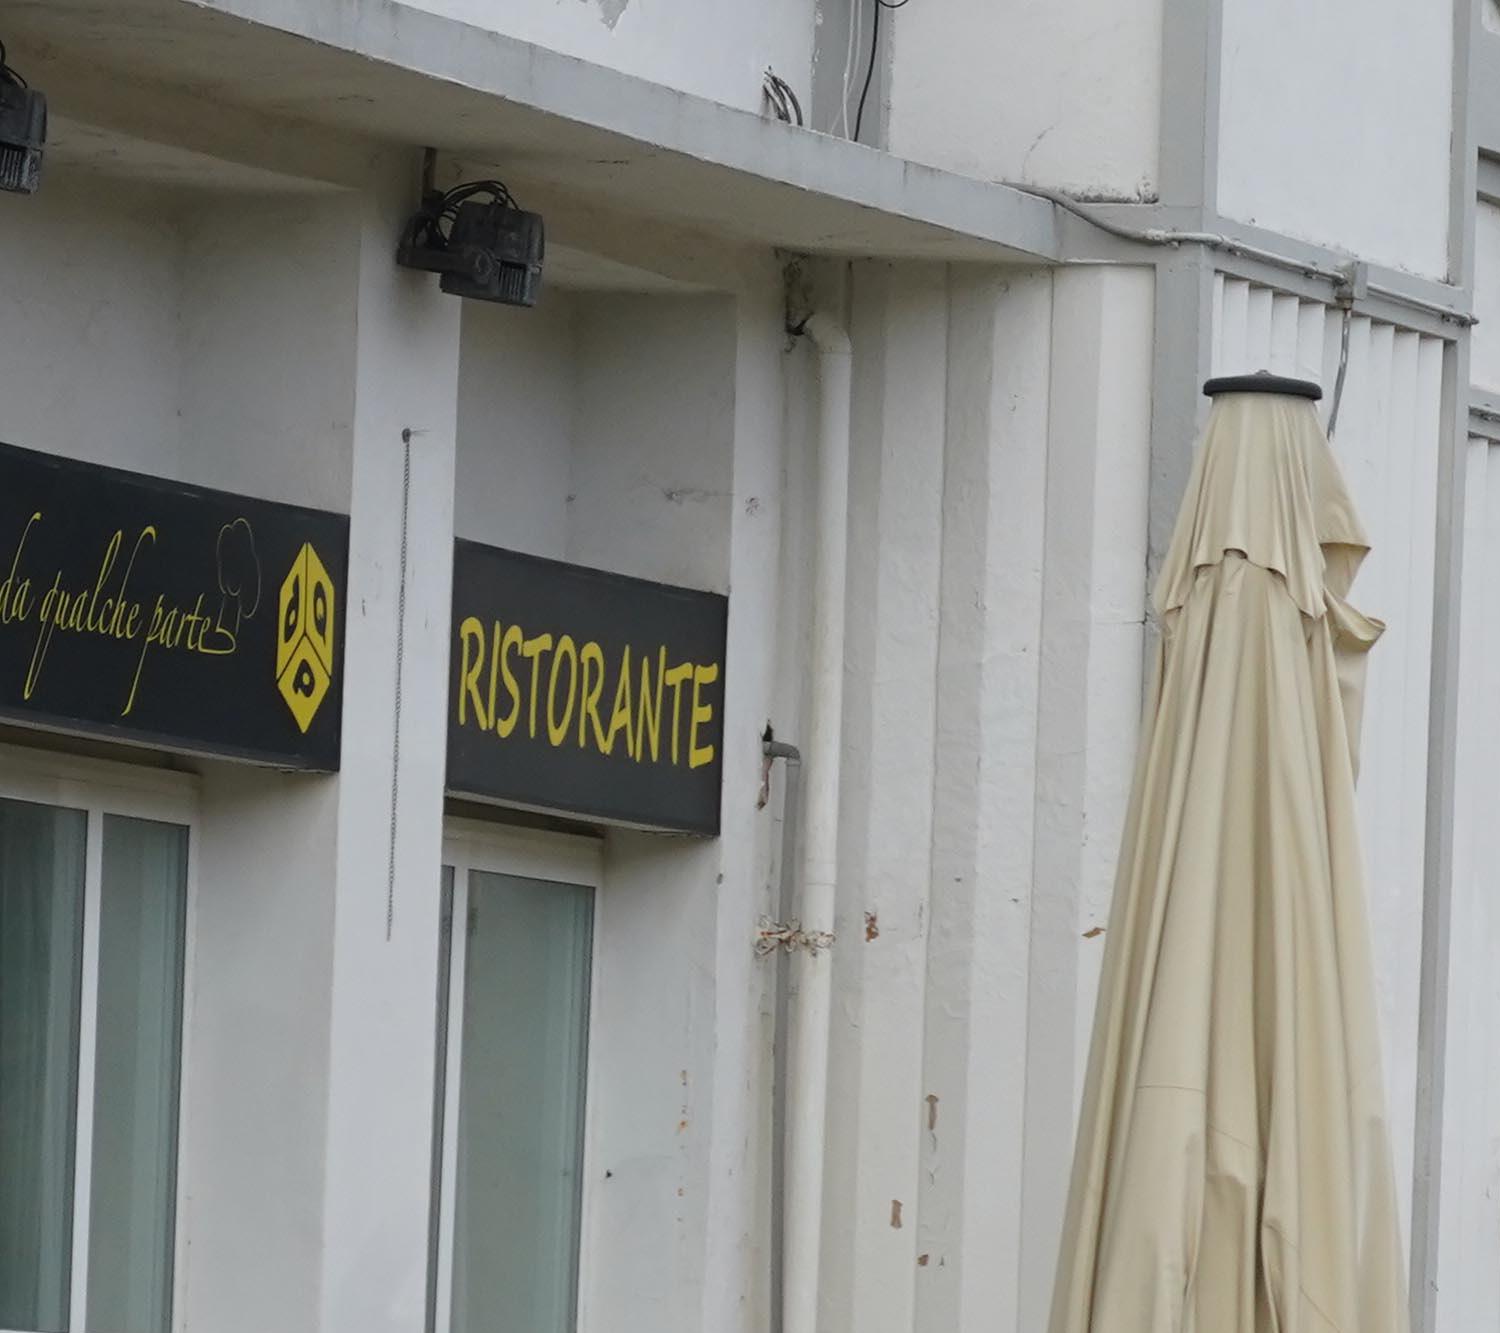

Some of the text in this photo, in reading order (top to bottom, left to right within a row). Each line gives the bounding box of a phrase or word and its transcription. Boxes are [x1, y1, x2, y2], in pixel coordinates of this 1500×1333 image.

[0, 511, 214, 717] da qualche parte
[459, 616, 718, 769] RISTORANTE
